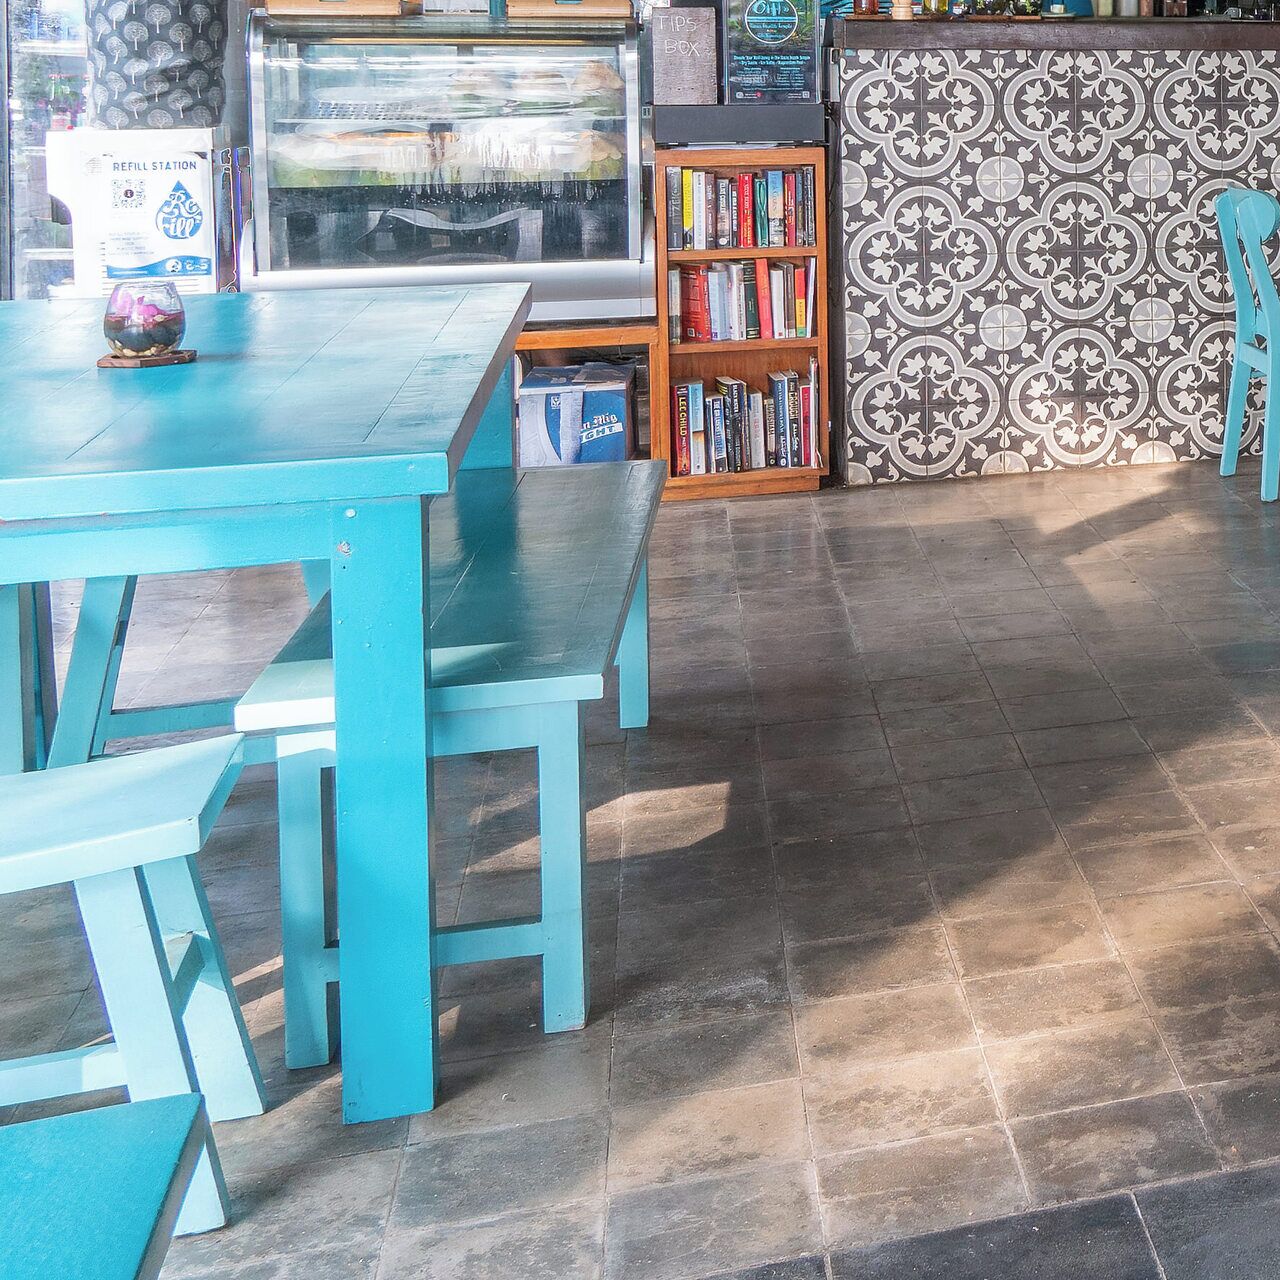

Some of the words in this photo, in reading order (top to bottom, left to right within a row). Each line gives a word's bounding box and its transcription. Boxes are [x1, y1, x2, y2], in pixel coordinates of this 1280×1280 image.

[657, 15, 697, 32] TIPS
[664, 39, 700, 57] BOX
[113, 162, 148, 171] REFILL
[152, 161, 197, 170] STATION
[679, 397, 687, 412] LEE
[679, 412, 688, 436] CHILD
[583, 425, 616, 441] GHT
